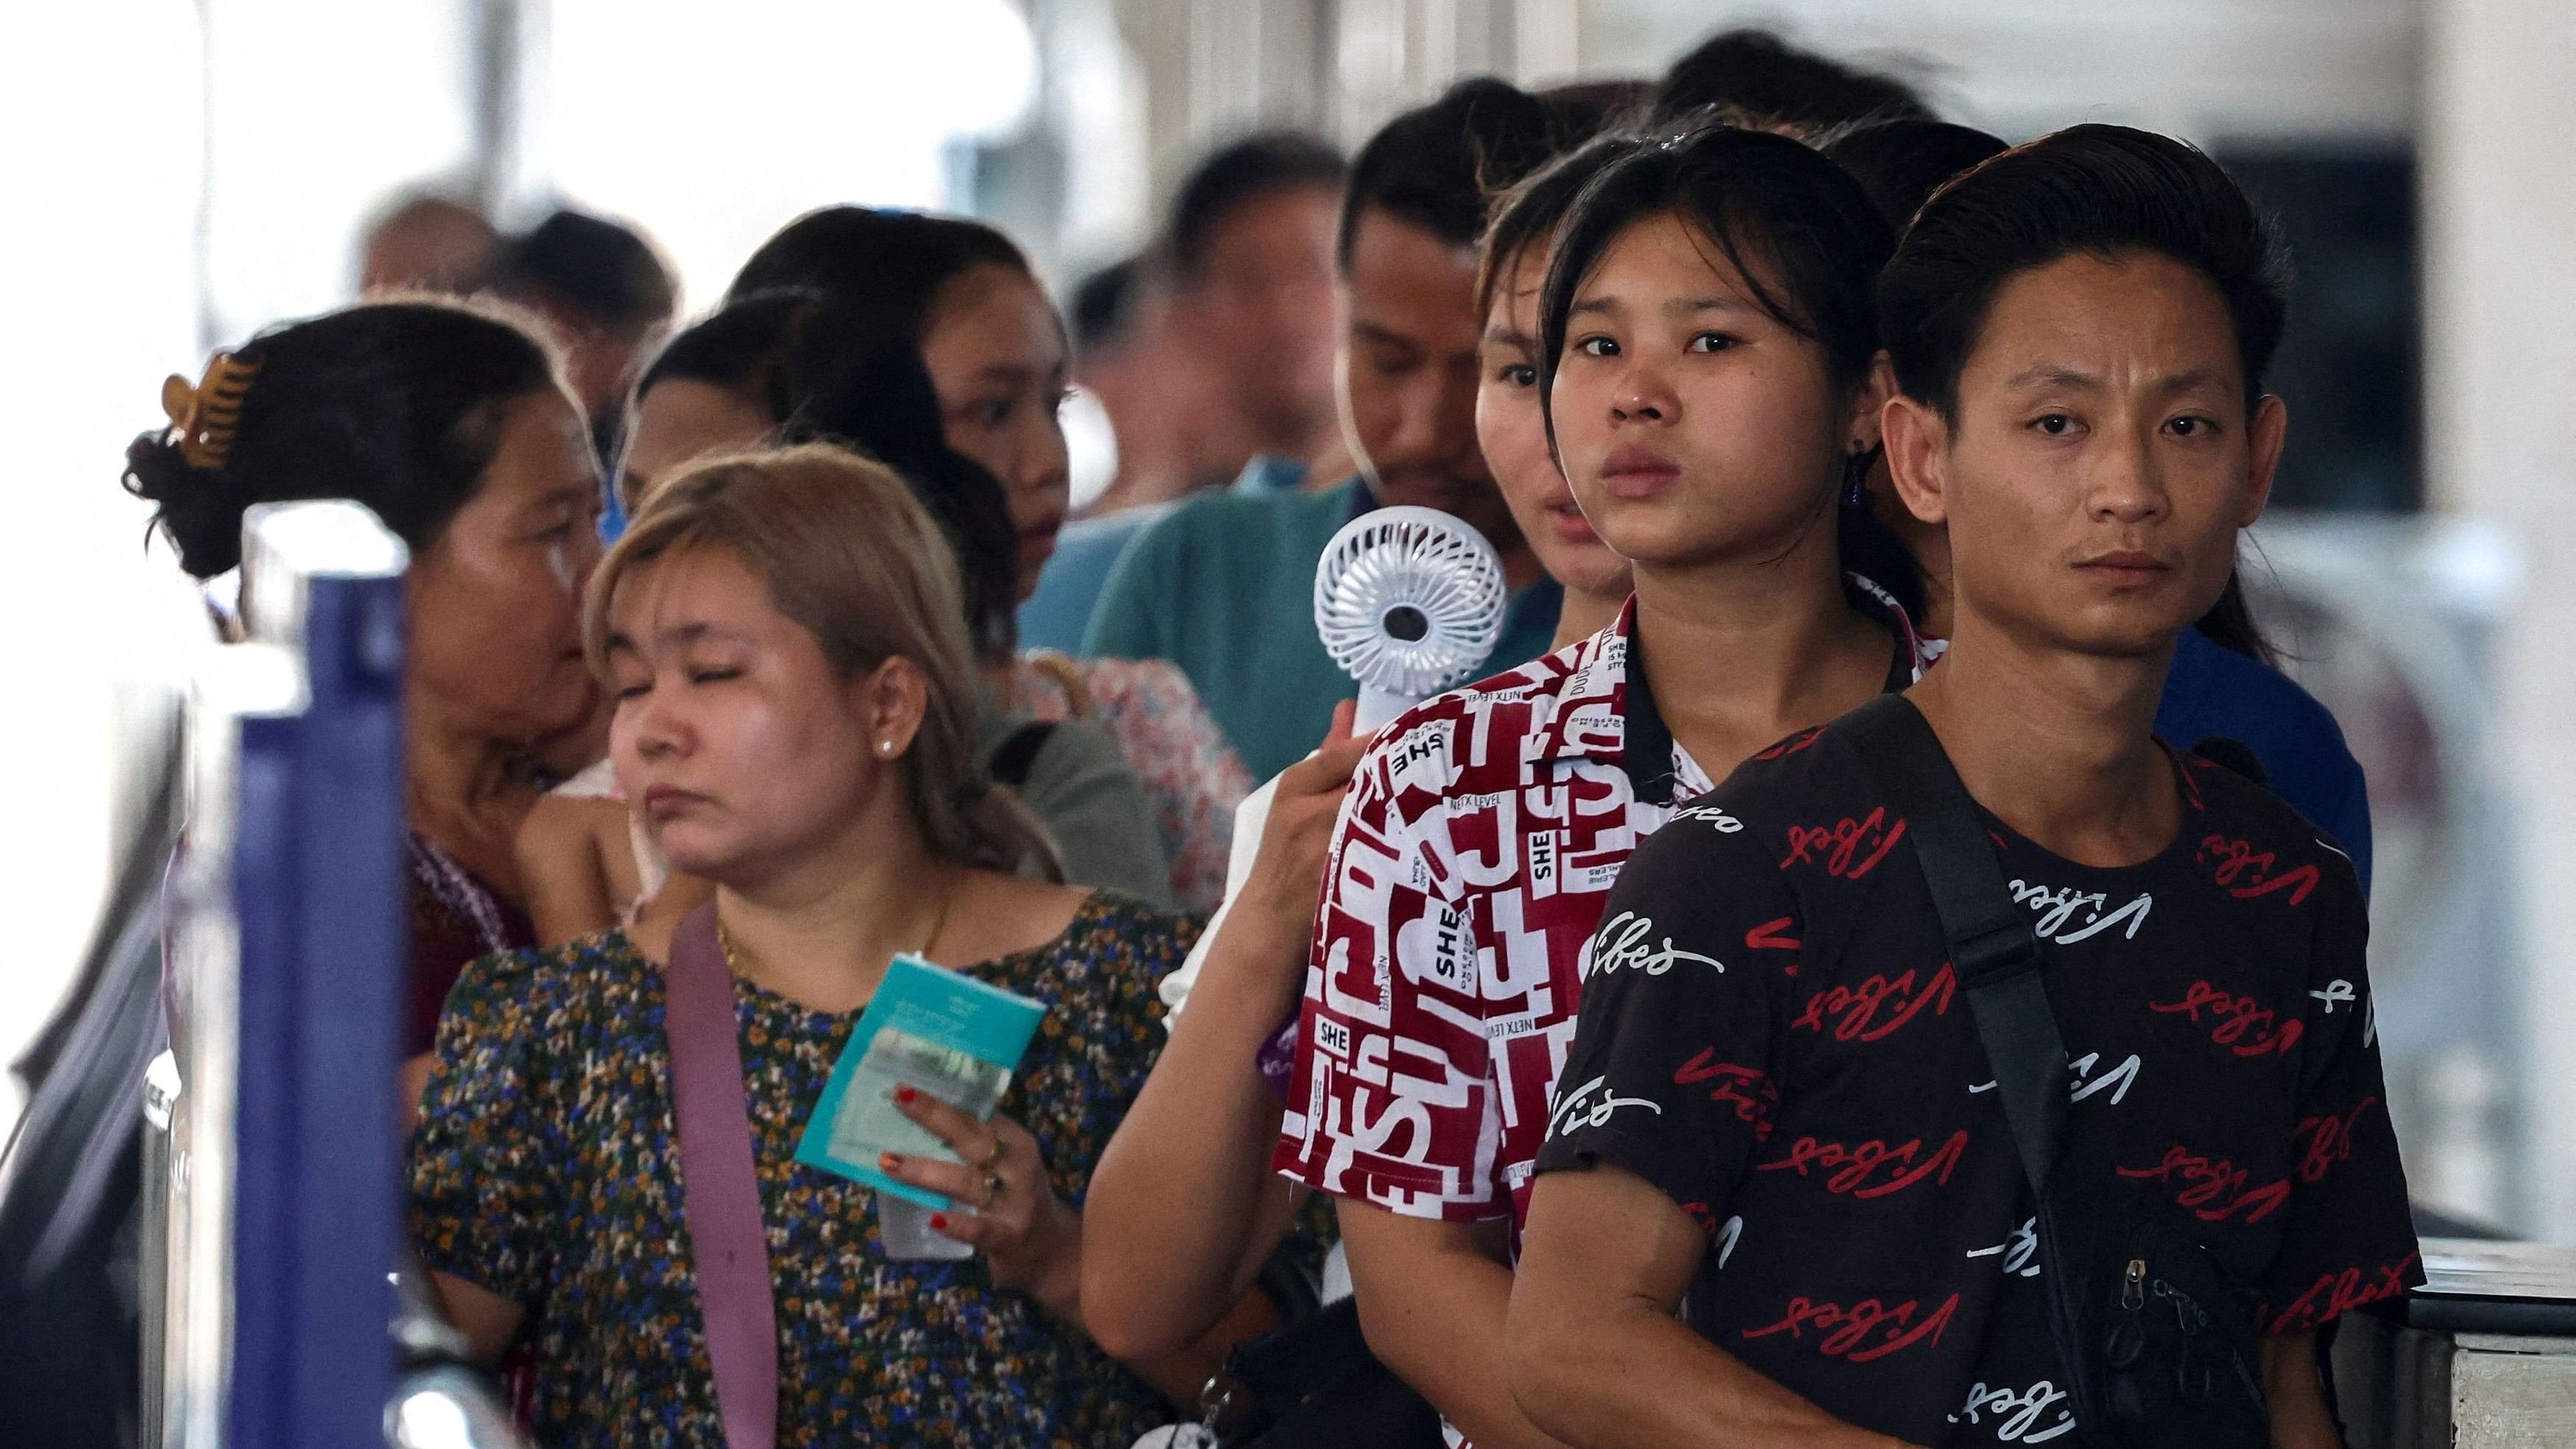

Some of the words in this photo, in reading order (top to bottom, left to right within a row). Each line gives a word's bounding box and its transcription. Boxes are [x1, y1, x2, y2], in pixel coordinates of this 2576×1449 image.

[1391, 733, 1443, 777] SHE
[1473, 794, 1501, 808] LEVEL
[1533, 833, 1551, 880] SHE
[1435, 907, 1459, 979] SHE
[1791, 961, 1958, 1042] Vibes
[1320, 1022, 1348, 1051] SHE
[1756, 1130, 1969, 1200] Vibes
[1742, 1292, 1960, 1361] Vibes
